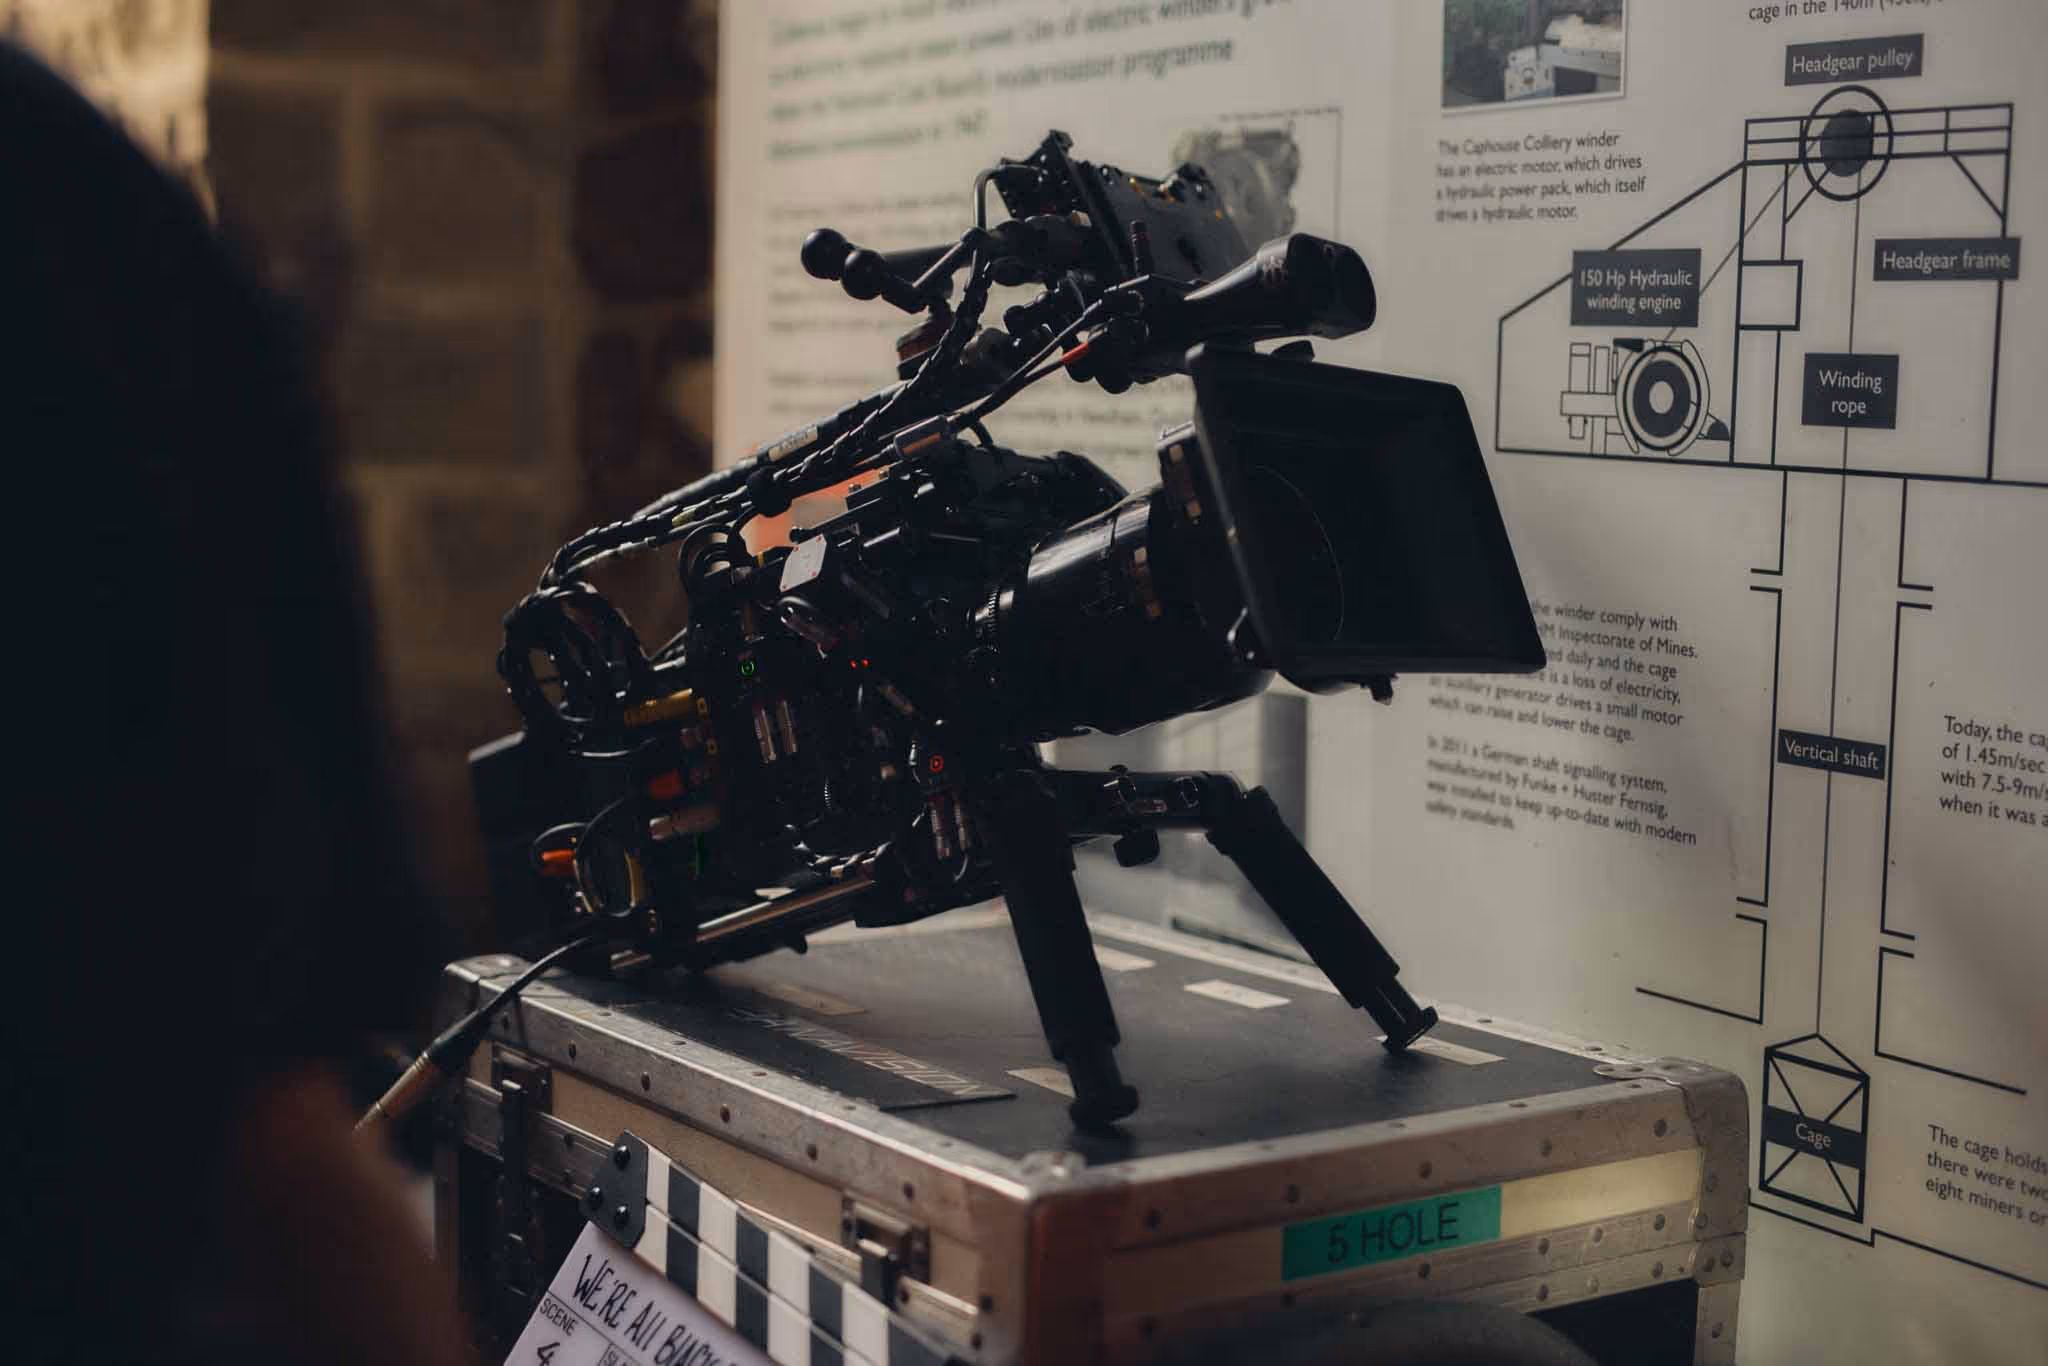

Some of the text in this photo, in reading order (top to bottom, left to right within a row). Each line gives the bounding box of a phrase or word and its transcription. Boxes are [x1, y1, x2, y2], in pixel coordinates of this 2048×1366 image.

[1749, 5, 1780, 23] cage
[1785, 1, 1797, 16] in
[1803, 0, 1826, 14] the
[1792, 48, 1913, 76] Headgear pulley
[1439, 138, 1459, 156] The
[1523, 133, 1572, 155] Colliery
[1576, 131, 1619, 147] winder
[1475, 160, 1518, 176] electric
[1521, 159, 1562, 175] motor,
[1564, 155, 1600, 171] which
[1604, 153, 1643, 170] drives
[1446, 183, 1496, 202] hydraulic
[1499, 184, 1536, 201] power
[1540, 180, 1571, 198] pack,
[1574, 177, 1611, 194] which
[1615, 175, 1647, 193] itself
[1481, 204, 1534, 223] hydraulic
[1537, 204, 1577, 219] motor.
[1882, 249, 2011, 274] Headgear frame
[1581, 268, 1693, 291] 150 Hp Hydraulic
[1586, 293, 1682, 314] winding engine
[1818, 368, 1883, 394] Winding
[1831, 400, 1867, 418] rope
[1555, 602, 1595, 621] winder
[1600, 610, 1645, 632] comply
[1650, 615, 1678, 632] with
[1559, 625, 1635, 650] Inspectorate
[1639, 636, 1653, 652] of
[1657, 637, 1698, 659] Mines.
[1566, 649, 1593, 670] daily
[1598, 656, 1620, 671] and
[1624, 656, 1645, 673] the
[1649, 663, 1677, 682] cage
[1562, 674, 1568, 685] a
[1573, 671, 1597, 689] loss
[1600, 677, 1613, 692] of
[1616, 680, 1681, 706] electricity,
[1555, 692, 1591, 712] drives
[1595, 702, 1602, 713] a
[1606, 703, 1638, 719] small
[1642, 708, 1685, 726] motor
[1517, 709, 1539, 724] and
[1542, 711, 1576, 730] lower
[1580, 719, 1600, 735] the
[1603, 724, 1634, 744] cage.
[1944, 714, 2048, 753] Today, the ca
[1783, 735, 1880, 771] Vertical shaft
[1942, 743, 1960, 760] of
[1563, 761, 1617, 788] signalling
[1620, 772, 1668, 795] system,
[1940, 769, 1976, 789] with
[1572, 782, 1616, 806] Huster
[1515, 794, 1543, 817] keep
[1614, 815, 1641, 833] with
[1645, 822, 1697, 845] modern
[1939, 794, 1983, 817] when
[1988, 801, 2001, 819] it
[2004, 807, 2037, 826] was
[1795, 1122, 1832, 1150] Cage
[1927, 1123, 2048, 1177] The cage holds
[1927, 1150, 1969, 1177] there
[1974, 1166, 2017, 1190] were
[1925, 1177, 1964, 1202] eight
[1968, 1190, 2024, 1219] miners
[1327, 1200, 1460, 1264] 5 HOLE
[573, 1253, 637, 1329] WE'RE
[539, 1298, 579, 1337] SCENE
[536, 1341, 561, 1366] 4
